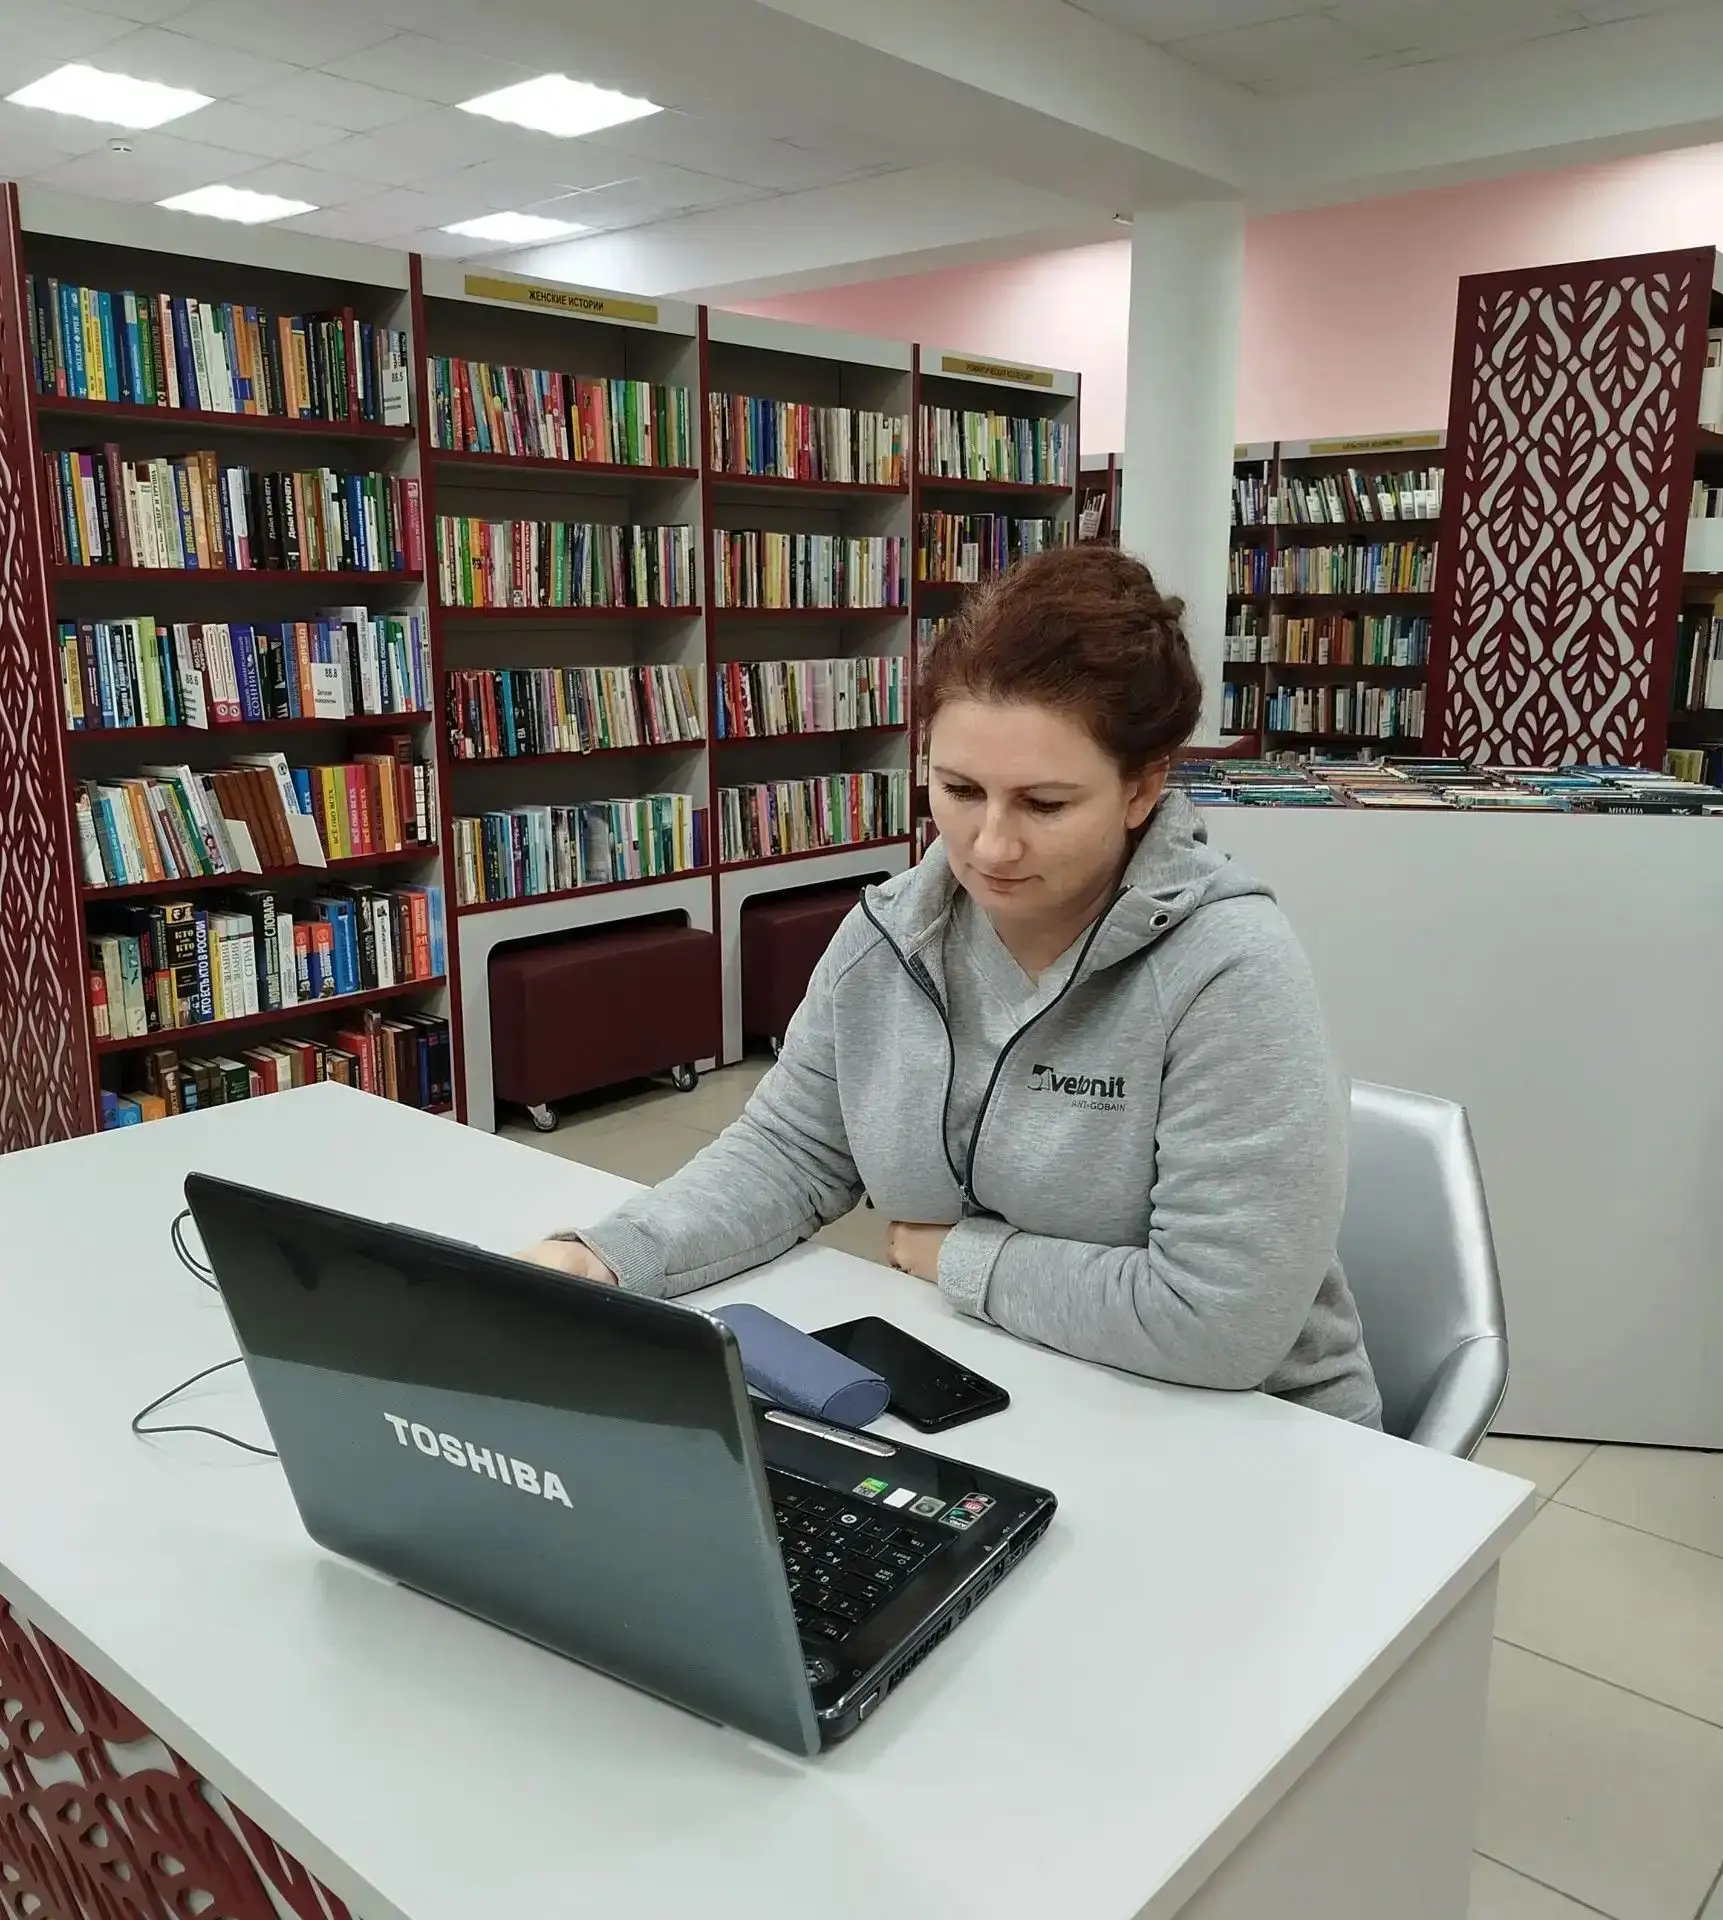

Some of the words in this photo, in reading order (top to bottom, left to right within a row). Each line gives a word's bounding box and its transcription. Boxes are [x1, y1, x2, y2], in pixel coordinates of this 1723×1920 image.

[528, 290, 567, 305] ЖЕНСКИЕ
[568, 296, 604, 311] ИСТОРИИ
[178, 470, 189, 511] ОБЩЕНИЕ
[264, 477, 272, 515] КАРНЕГИ
[284, 477, 292, 515] КАРНЕГИ
[184, 514, 194, 553] ДЕЛОВОЕ
[287, 516, 295, 538] Дейл
[191, 639, 199, 668] ЖЕСТОВ
[196, 638, 205, 671] СЛОВАРЬ
[299, 627, 307, 664] ФРЕЙД
[248, 667, 260, 716] СОННИК
[263, 896, 275, 936] СЛОВАРЬ
[175, 929, 194, 939] КТО
[176, 943, 195, 952] КТО
[196, 920, 205, 953] РОССИИ
[199, 961, 207, 977] КТО
[243, 939, 252, 976] СТРАН
[200, 977, 209, 996] ЕСТЬ
[268, 973, 279, 1002] НОВЫЙ
[202, 997, 210, 1013] КТО
[384, 1412, 574, 1508] TOSHIBA
